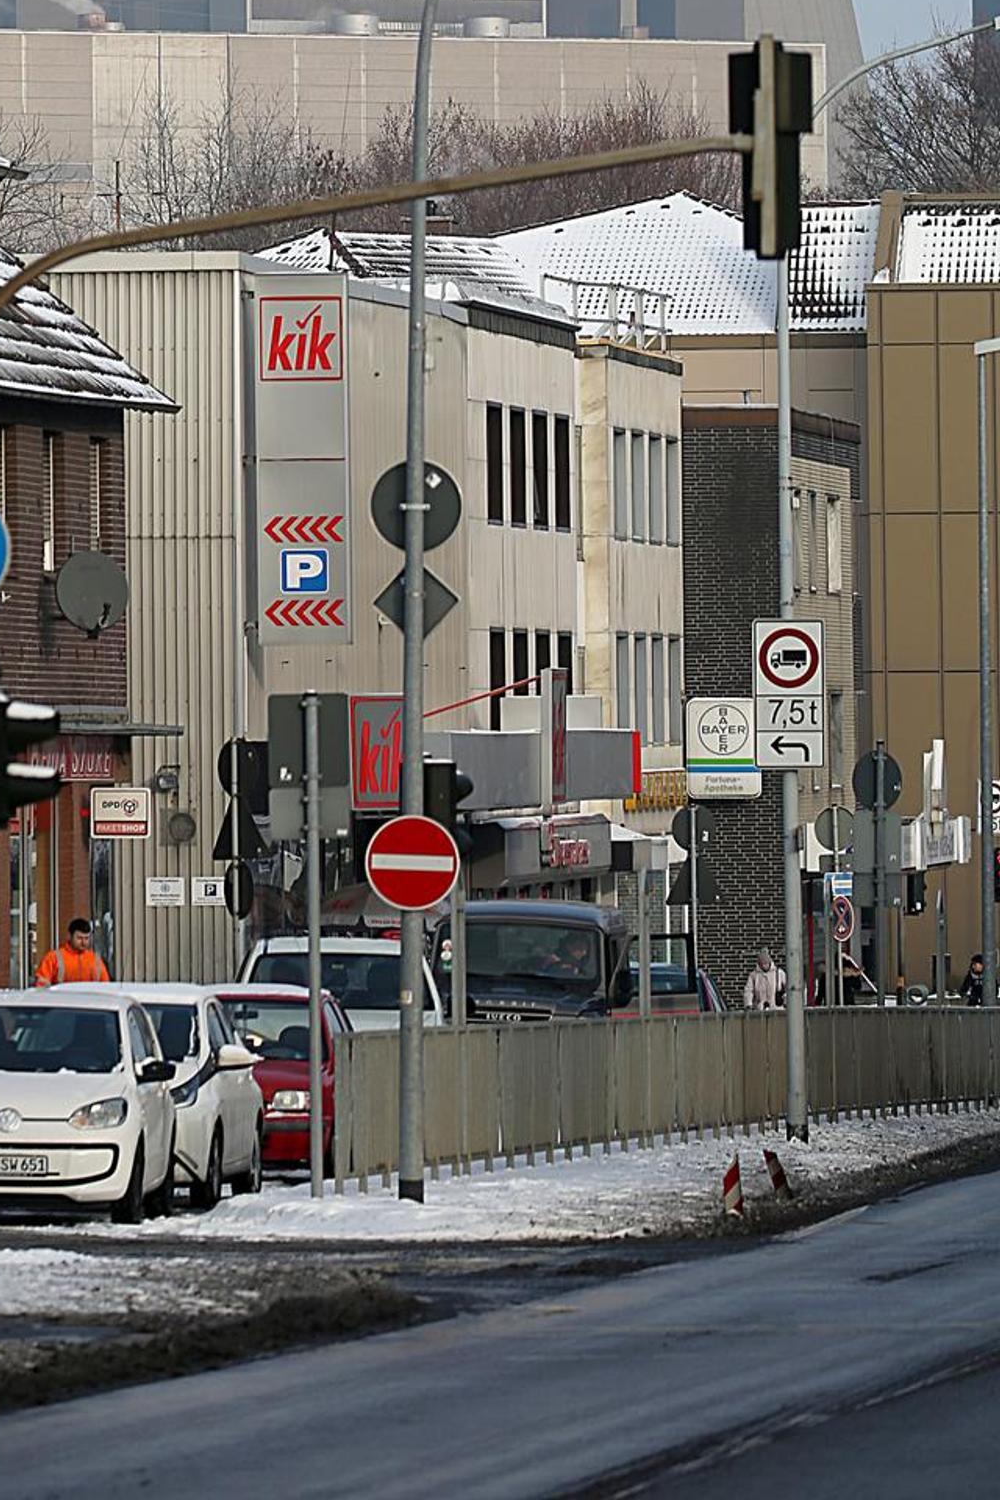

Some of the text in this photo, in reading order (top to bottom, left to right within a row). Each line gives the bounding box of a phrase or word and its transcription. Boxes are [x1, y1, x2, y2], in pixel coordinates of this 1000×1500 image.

[268, 304, 336, 371] kik
[286, 554, 323, 590] P
[701, 725, 746, 734] BAYER
[719, 708, 728, 752] BAYER
[101, 801, 120, 809] DPD
[96, 823, 146, 834] PAKETSHOP
[486, 1012, 522, 1021] IVECO
[0, 1158, 19, 1171] SW
[20, 1158, 45, 1171] 651
